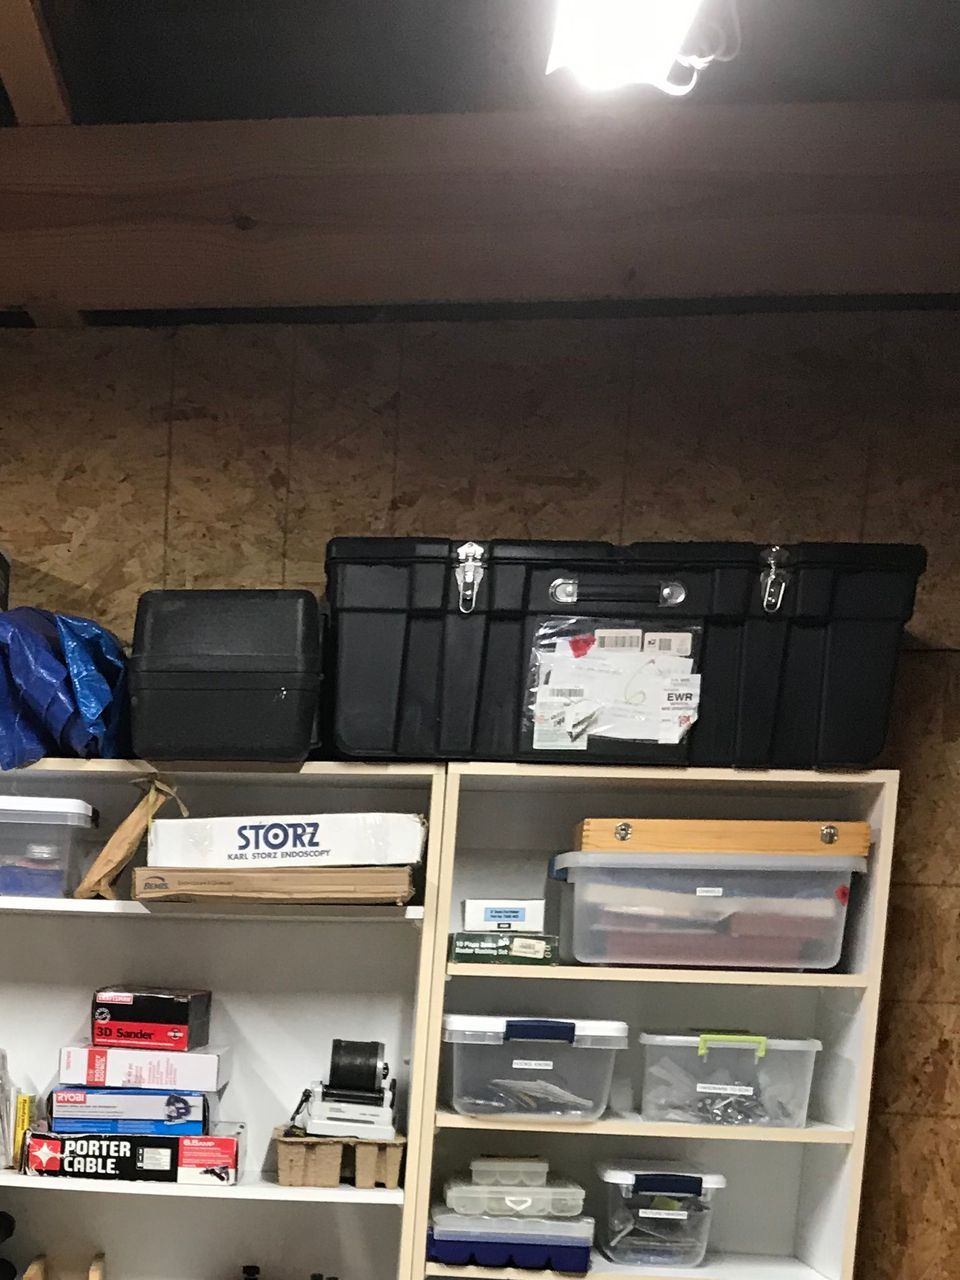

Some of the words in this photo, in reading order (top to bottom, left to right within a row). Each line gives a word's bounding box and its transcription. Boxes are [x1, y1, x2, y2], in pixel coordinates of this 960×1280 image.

[667, 693, 693, 702] EWR
[238, 823, 319, 850] STORZ
[252, 852, 278, 860] STORZ
[281, 850, 331, 859] ENDOSCOPY
[96, 1027, 112, 1037] 3D
[116, 1029, 155, 1039] Sander
[57, 1093, 85, 1102] RYOBI
[64, 1140, 131, 1158] PORTER
